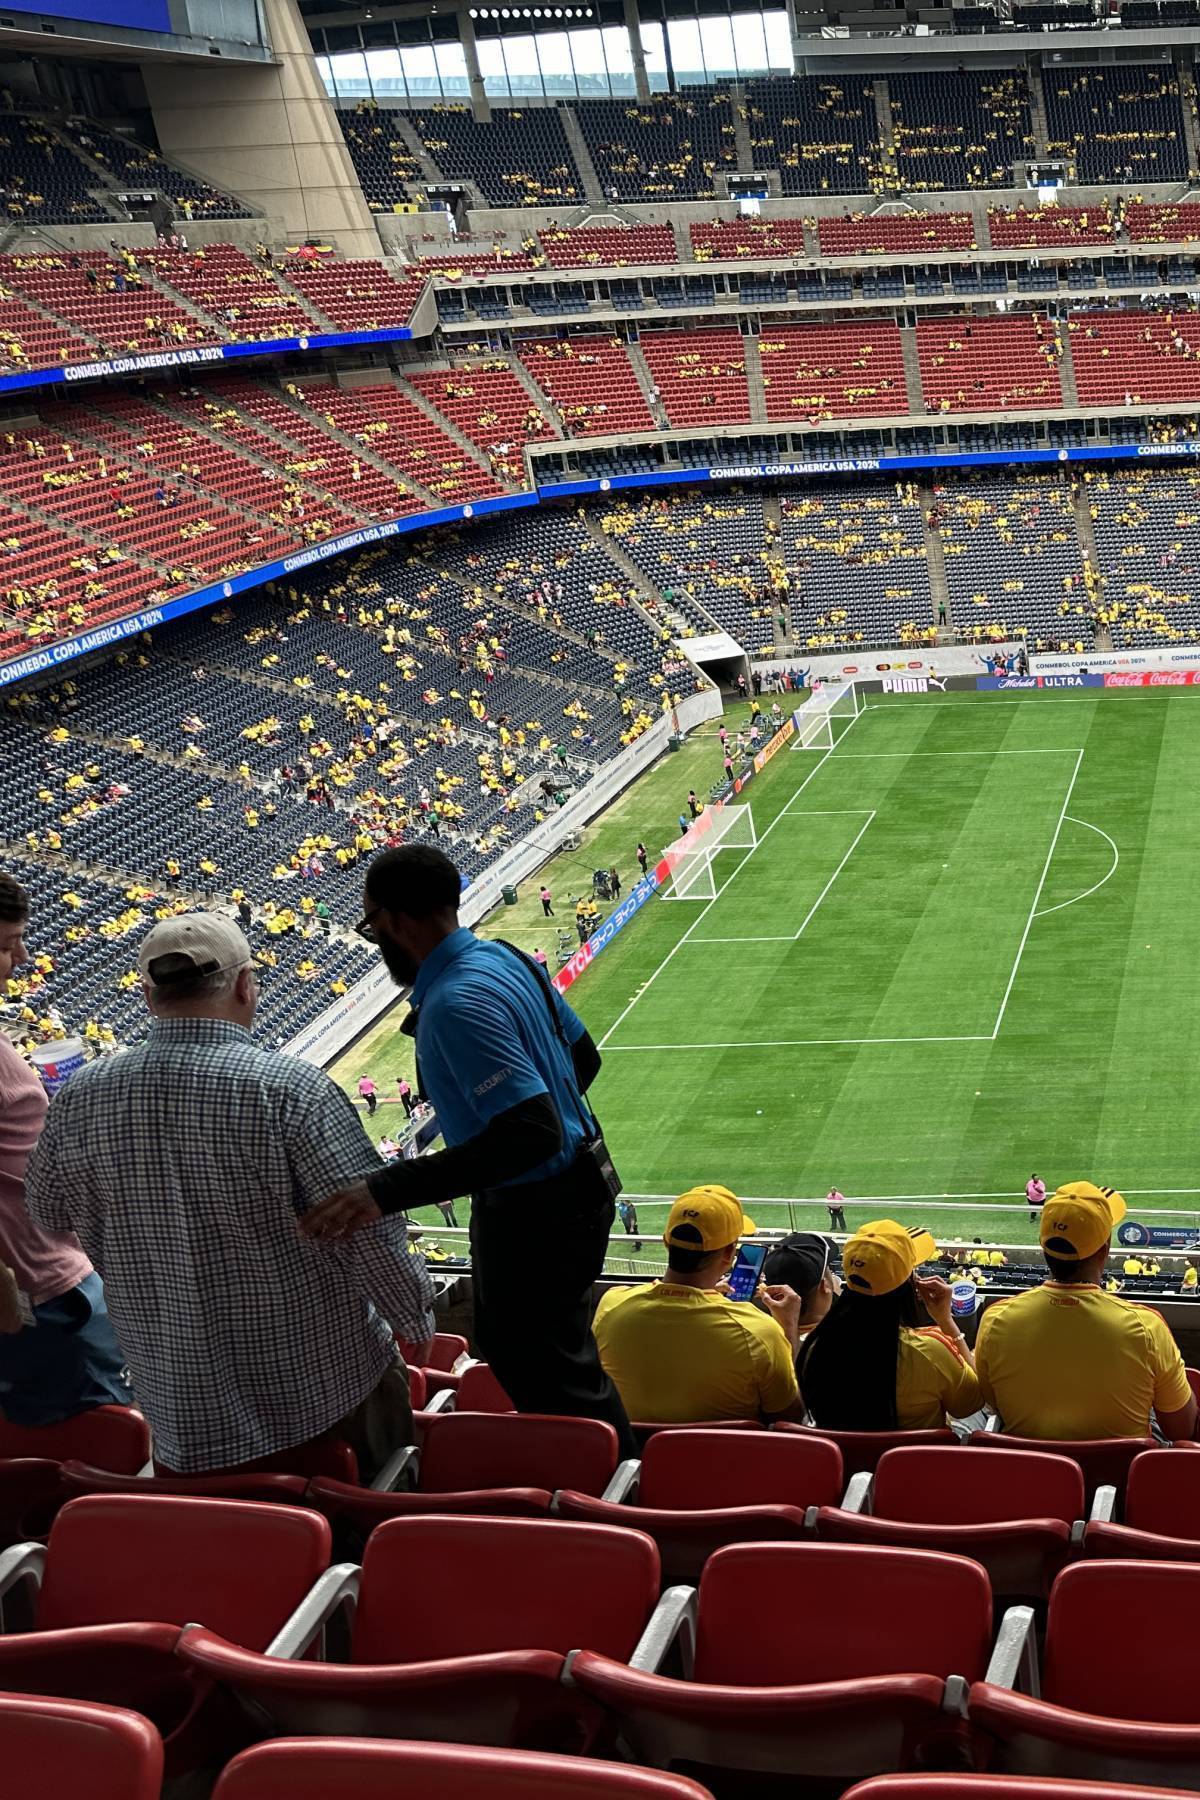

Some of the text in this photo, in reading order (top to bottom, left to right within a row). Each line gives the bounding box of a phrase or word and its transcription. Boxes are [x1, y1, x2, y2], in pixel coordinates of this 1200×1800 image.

[65, 347, 224, 380] CONMEBOL COPA AMERICA USA 2024
[1137, 444, 1189, 455] CONMEBOL
[709, 459, 880, 479] CONMEBOL COPA AMERICA USA 2024
[283, 522, 400, 572] CONMEBOL COPA AMERICA USA 2024
[53, 642, 82, 660] COPA
[82, 626, 124, 650] AMERICA
[122, 620, 142, 634] USA
[141, 610, 163, 627] 2024
[882, 678, 928, 693] PUMA
[998, 676, 1083, 689] Michelob ULTRA
[636, 875, 657, 903] BYD
[614, 898, 636, 926] BYD
[591, 924, 614, 953] BYD
[566, 947, 594, 979] TCL
[473, 1067, 512, 1096] SECURITY
